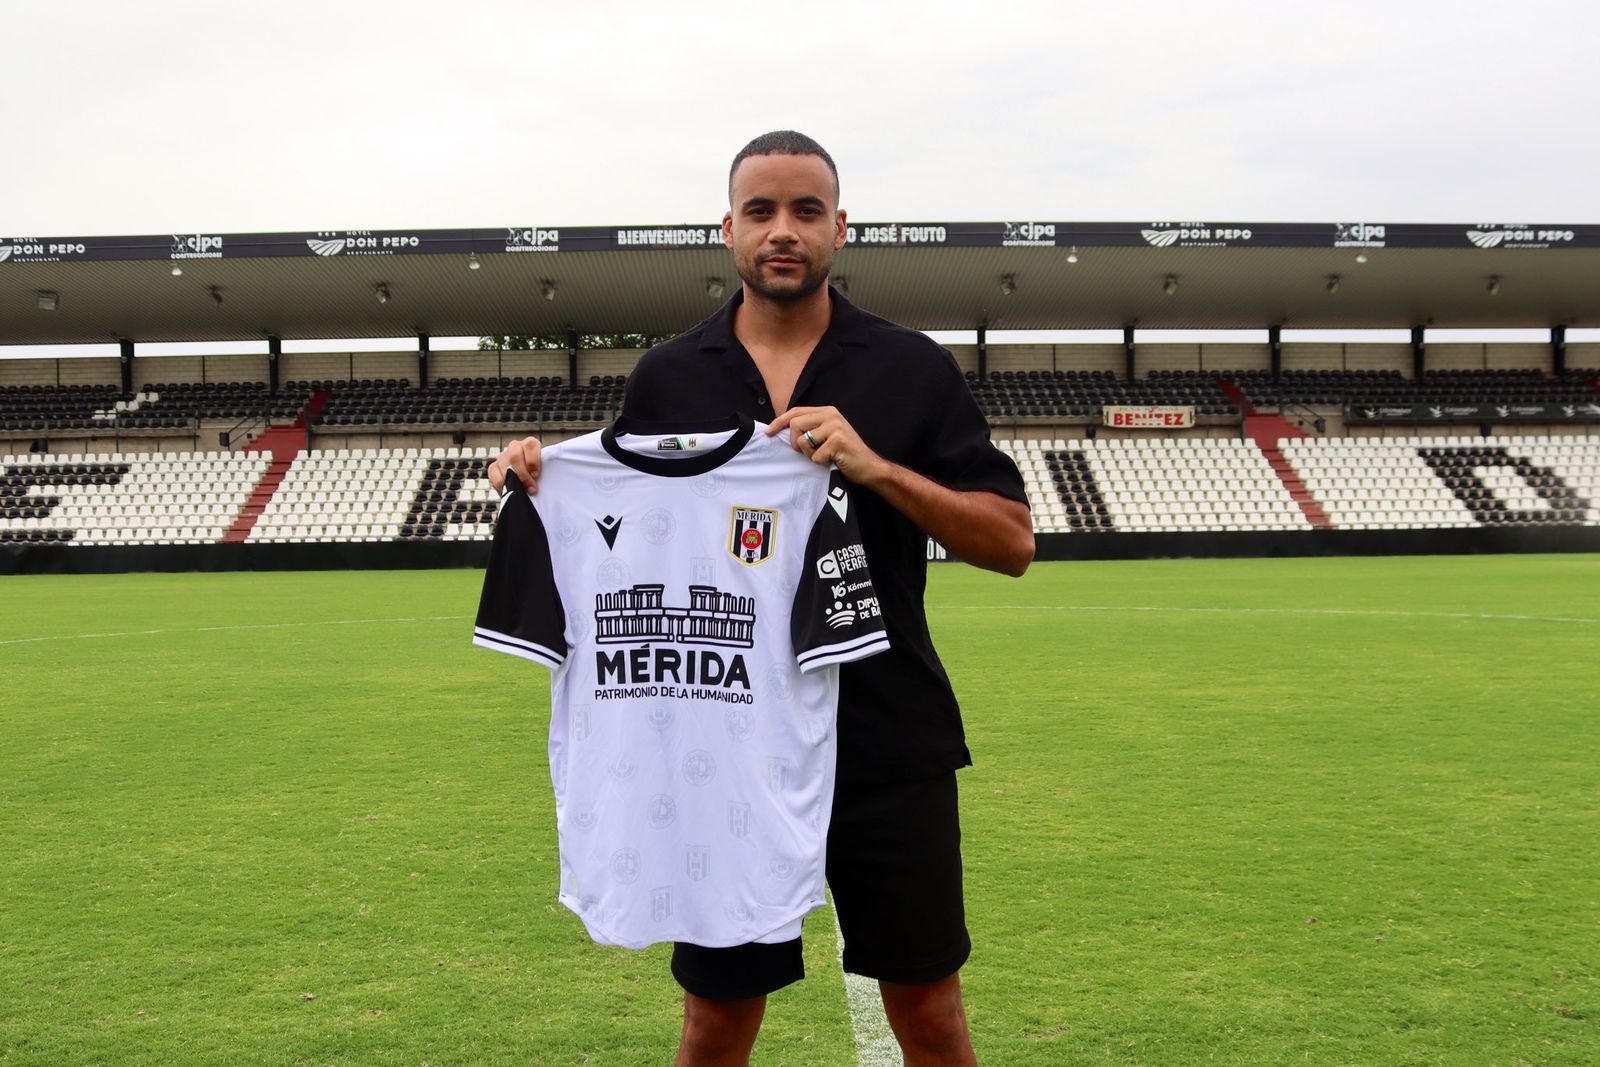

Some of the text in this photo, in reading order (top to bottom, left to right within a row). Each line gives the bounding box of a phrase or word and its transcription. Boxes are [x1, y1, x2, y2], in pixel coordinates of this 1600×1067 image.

[617, 229, 706, 245] BIENVENIDOS
[860, 223, 897, 243] JOSÉ
[901, 226, 946, 243] FOUTO
[1180, 229, 1252, 240] DON PEPO
[1504, 230, 1574, 241] DON PEPO
[13, 243, 85, 254] DON PEPO
[346, 236, 419, 248] DON PEPO
[596, 643, 751, 690] MÉRIDA
[595, 686, 754, 705] PATRIMONIO DE LA HUMANIDAD
